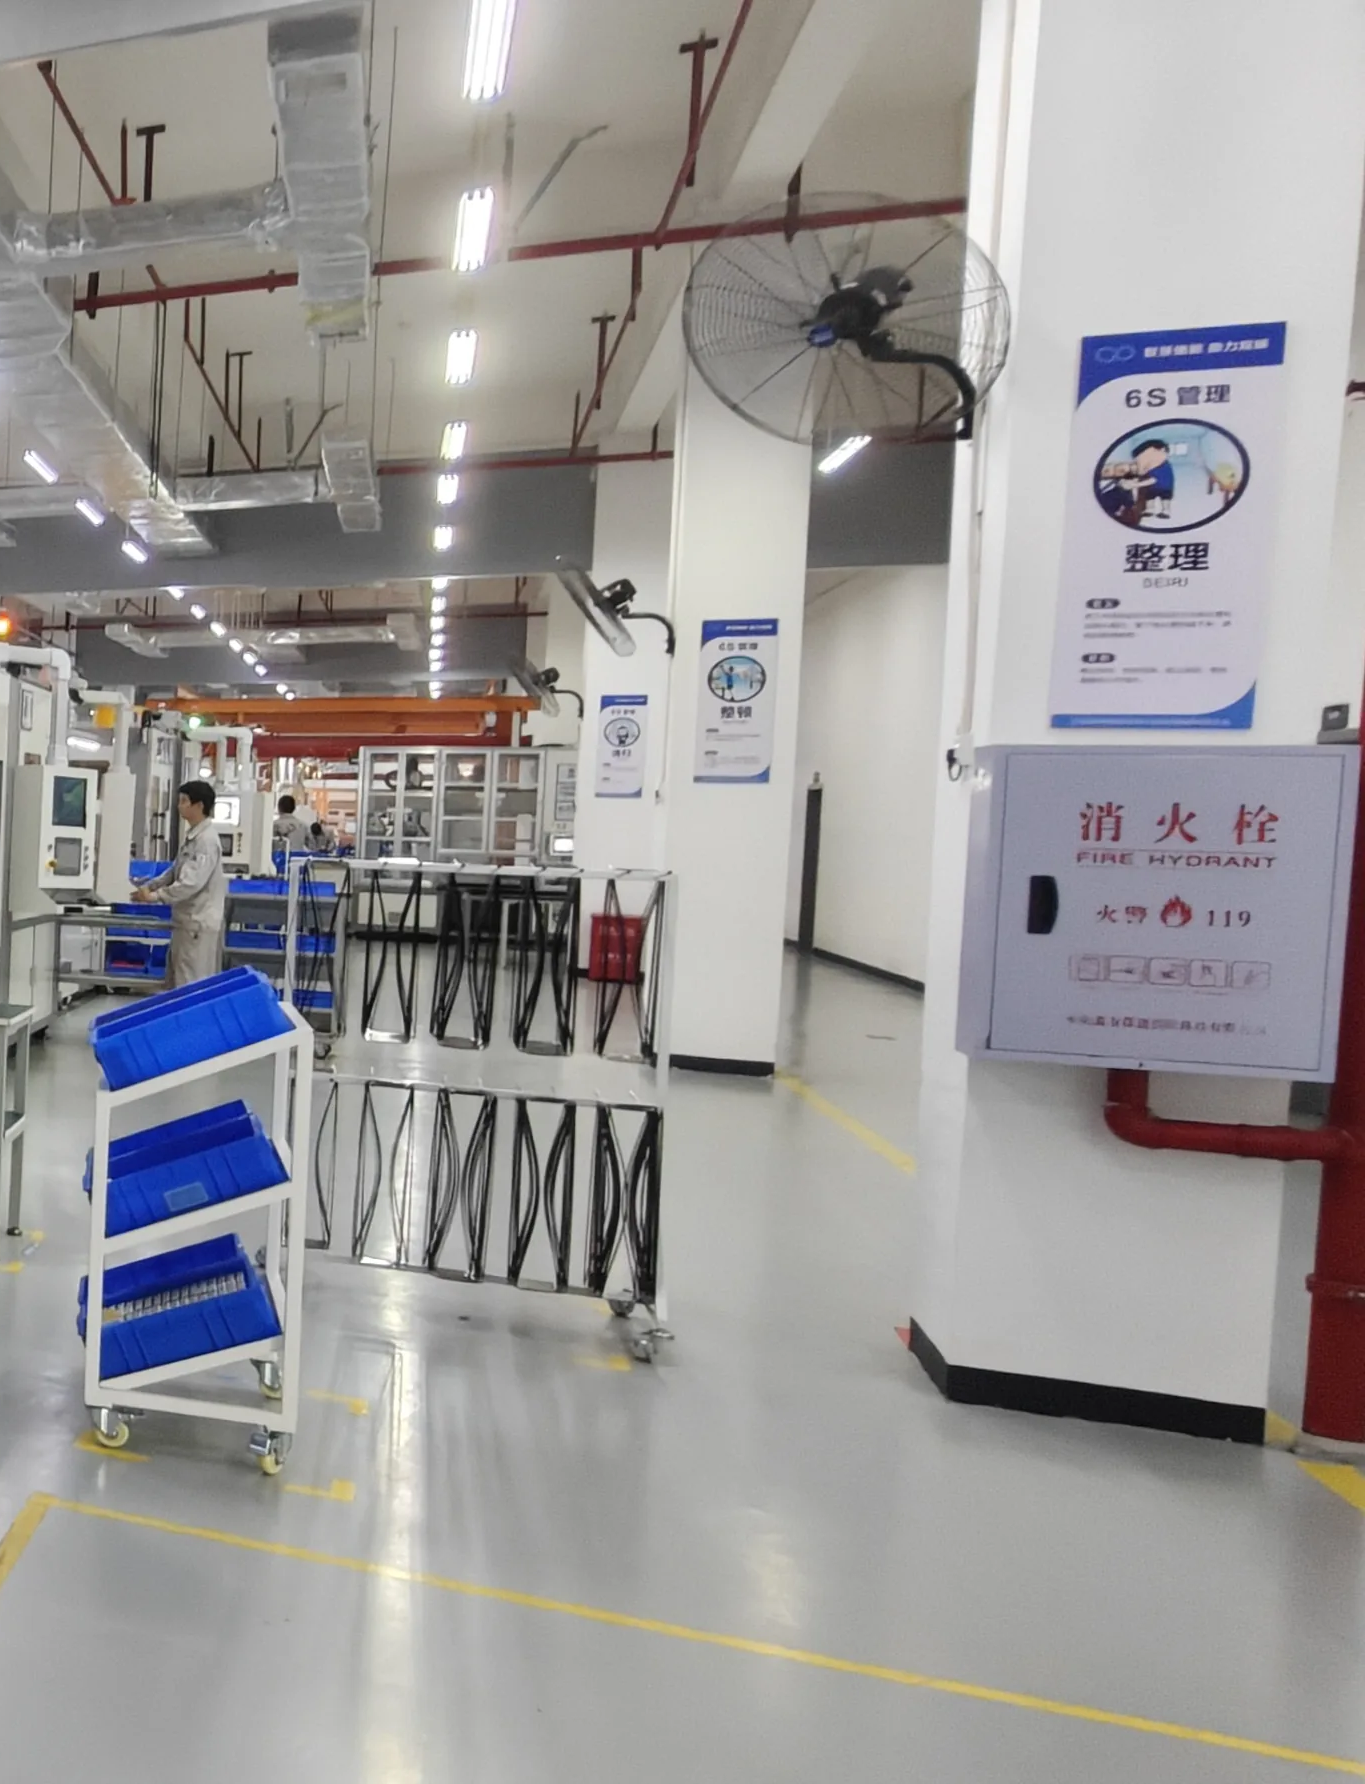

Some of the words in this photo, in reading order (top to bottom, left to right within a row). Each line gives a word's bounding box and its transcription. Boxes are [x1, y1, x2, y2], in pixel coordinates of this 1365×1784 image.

[1125, 387, 1167, 410] 6S
[1123, 542, 1210, 573] 整理
[1079, 802, 1280, 846] 消火栓
[1076, 851, 1133, 866] FIRE
[1148, 853, 1278, 870] HYDRANT
[1206, 909, 1252, 928] 119
